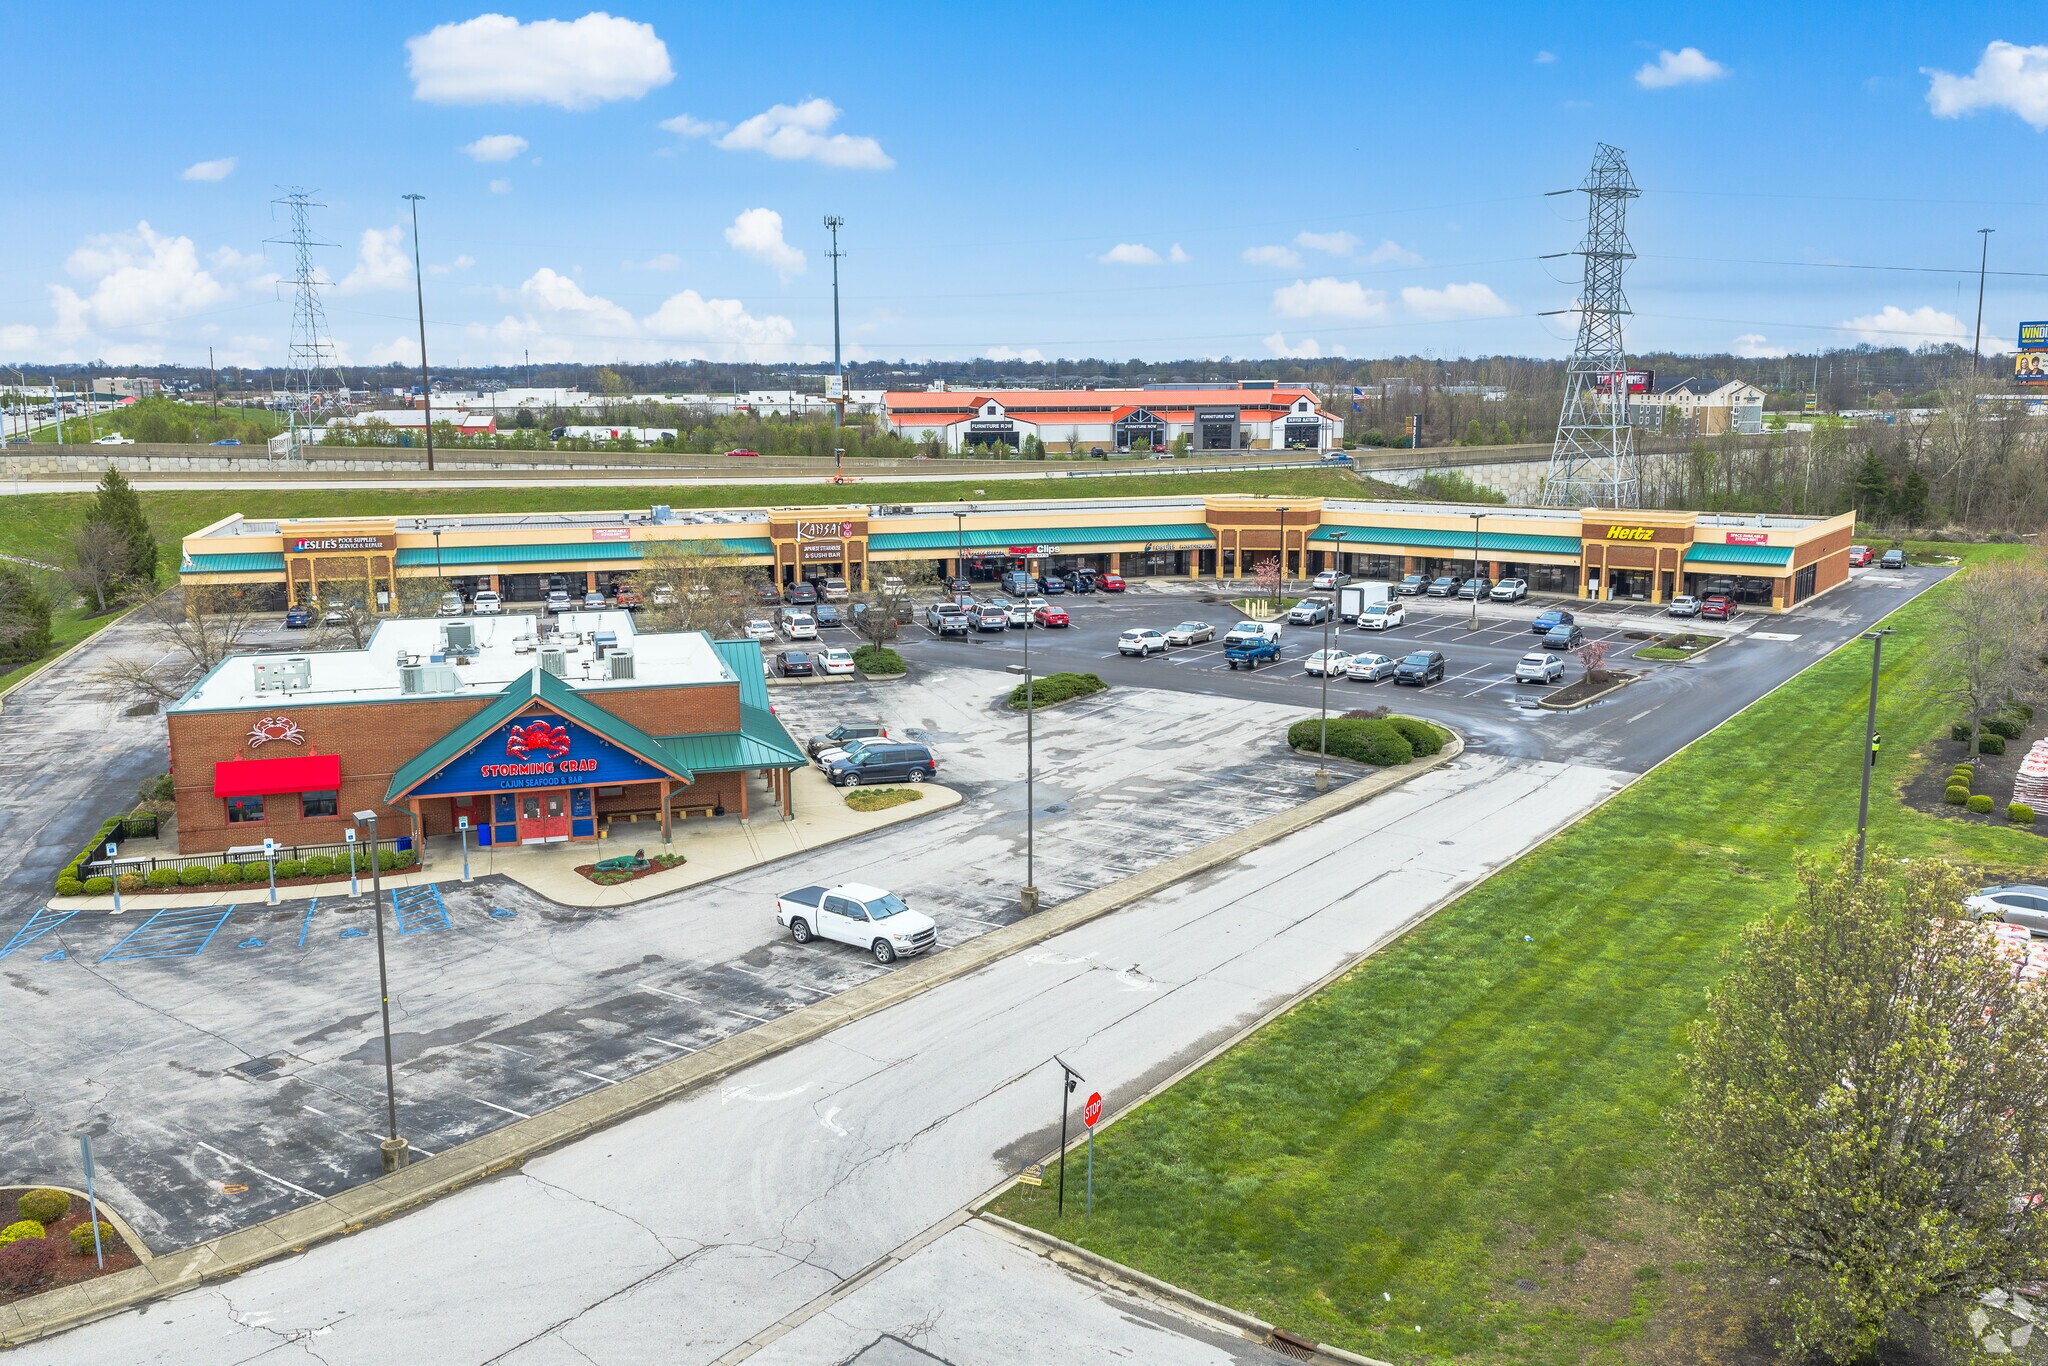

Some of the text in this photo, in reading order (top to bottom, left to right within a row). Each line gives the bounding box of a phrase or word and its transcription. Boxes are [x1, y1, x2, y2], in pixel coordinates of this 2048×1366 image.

[1606, 525, 1655, 541] Hertz
[298, 538, 337, 550] LESLIE'S
[1036, 545, 1060, 554] Clips
[481, 758, 598, 778] STORMING CRAB
[500, 780, 525, 789] CAJUN
[525, 777, 560, 787] SEAFOOD
[568, 776, 583, 784] BAR
[1085, 1099, 1101, 1120] STOP
